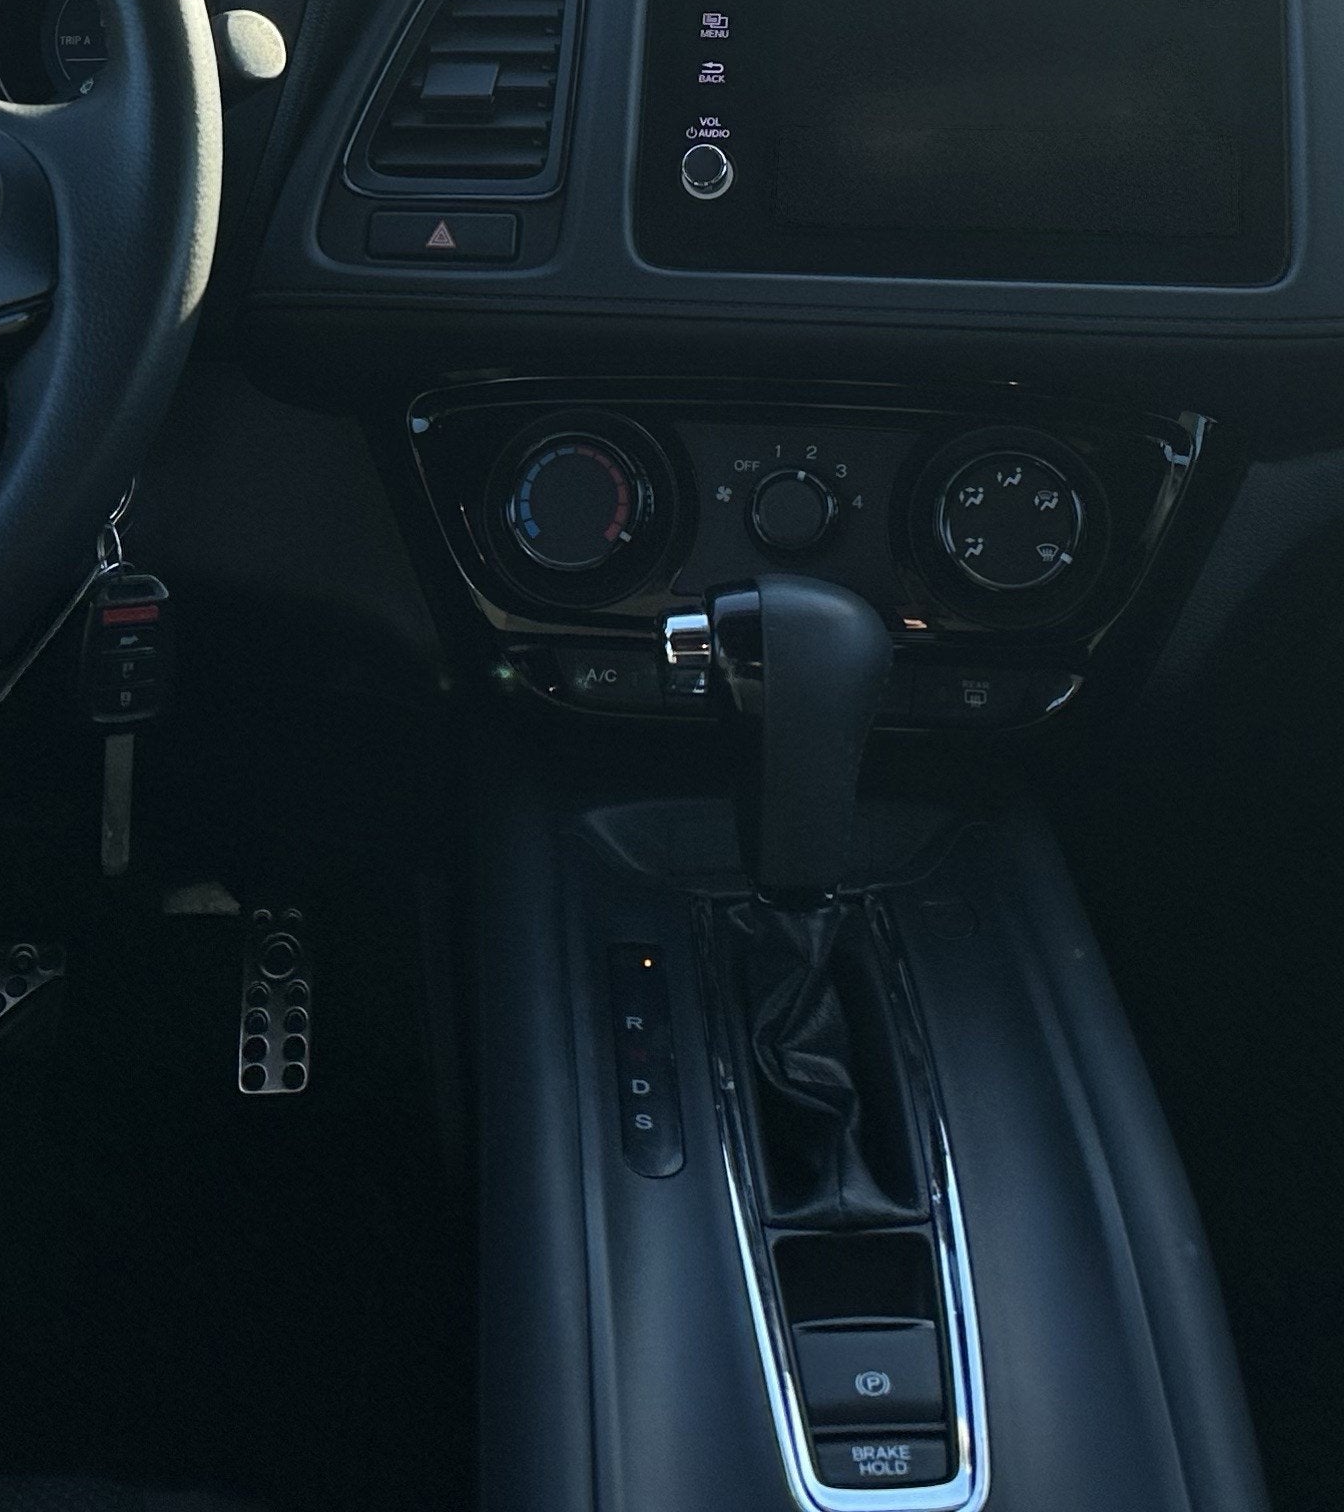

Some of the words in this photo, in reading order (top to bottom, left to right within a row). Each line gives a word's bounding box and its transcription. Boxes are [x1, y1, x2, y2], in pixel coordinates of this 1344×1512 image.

[700, 29, 729, 38] MENU
[60, 36, 81, 46] TRIP
[84, 36, 91, 46] A
[698, 74, 725, 83] BACK
[699, 117, 721, 127] VOL
[698, 129, 730, 138] AUDIO
[774, 445, 781, 458] 1
[806, 445, 817, 459] 2
[733, 458, 760, 474] OFF
[836, 464, 847, 478] 3
[851, 495, 863, 509] 4
[585, 667, 617, 684] A/C
[626, 1016, 644, 1030] R
[632, 1079, 650, 1094] D
[635, 1114, 653, 1130] S
[852, 1446, 911, 1461] BRAKE
[859, 1461, 908, 1476] HOLD
